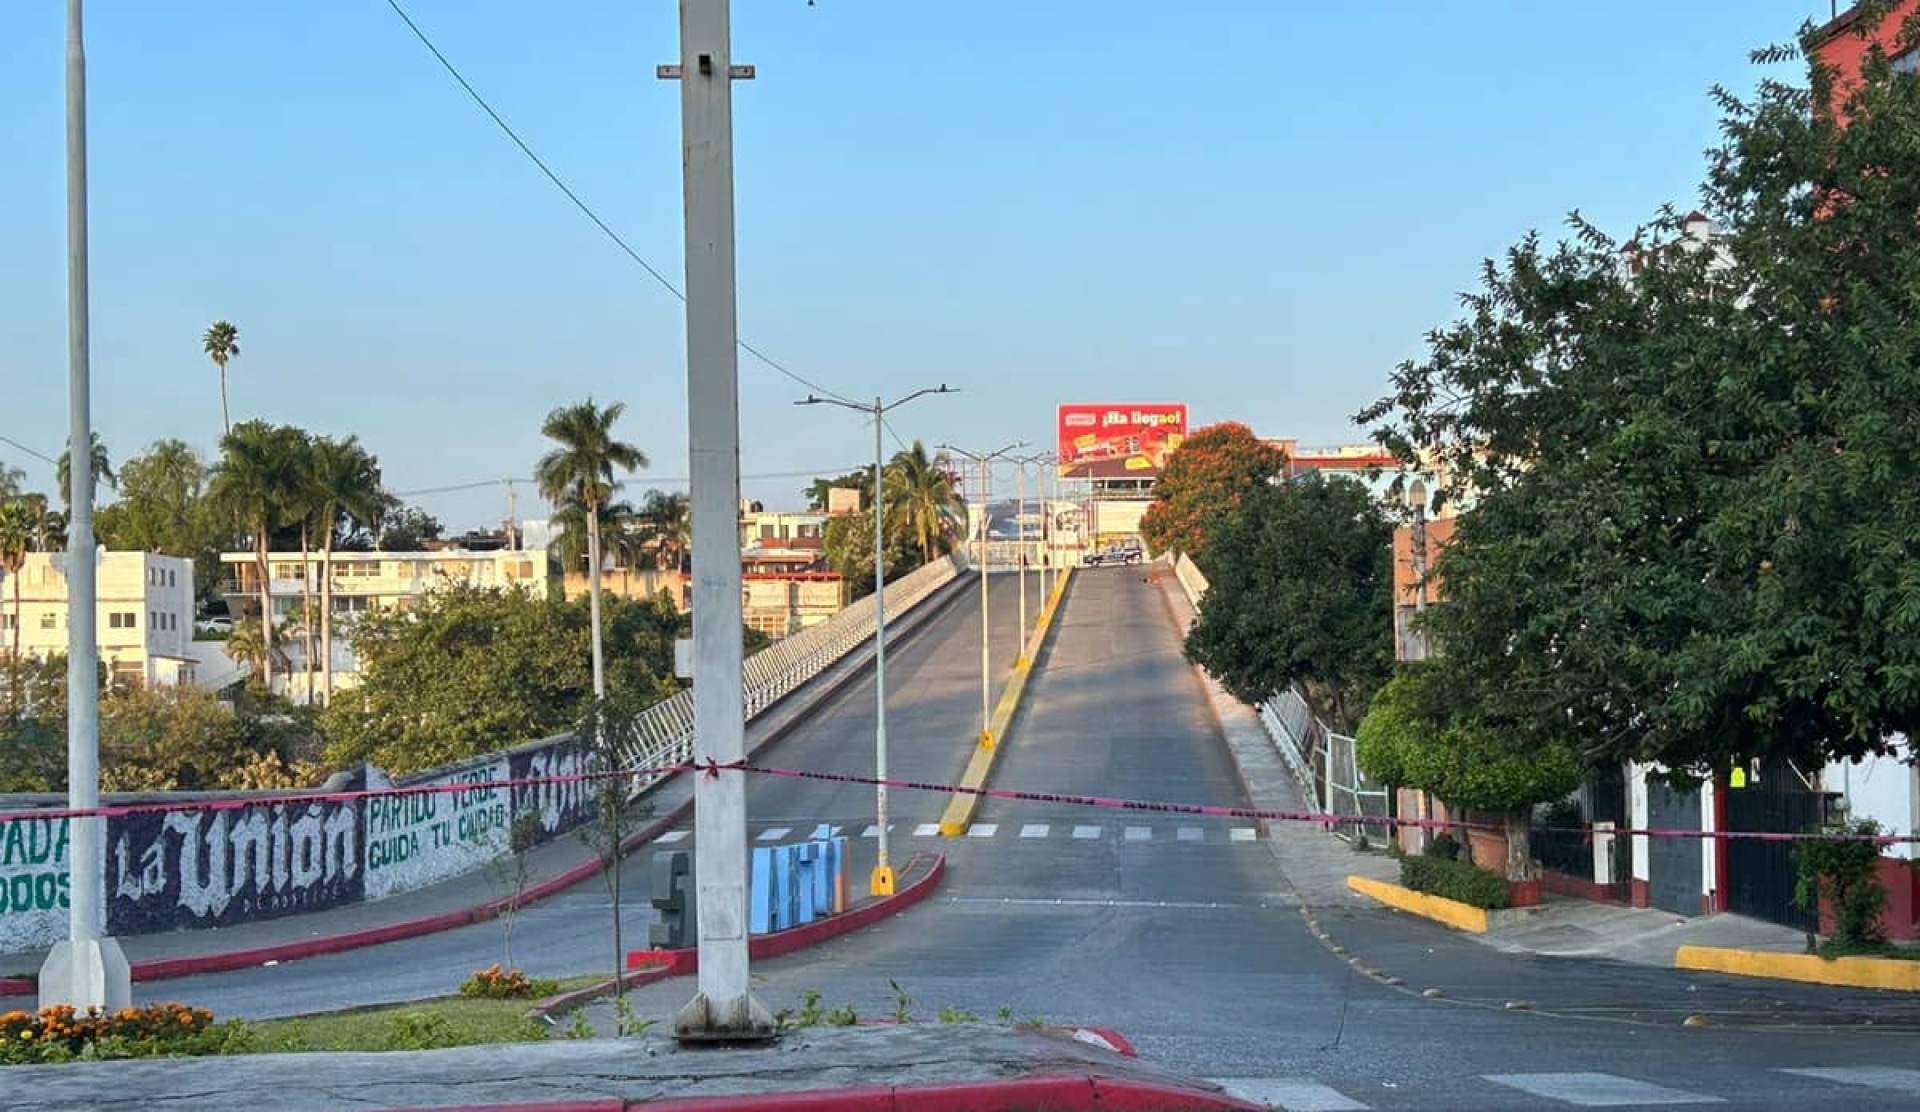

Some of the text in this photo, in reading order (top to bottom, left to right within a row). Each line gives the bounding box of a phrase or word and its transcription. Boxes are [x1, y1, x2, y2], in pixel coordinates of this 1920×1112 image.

[450, 766, 497, 811] VERDE
[431, 818, 451, 848] TU
[115, 802, 357, 918] La Unión
